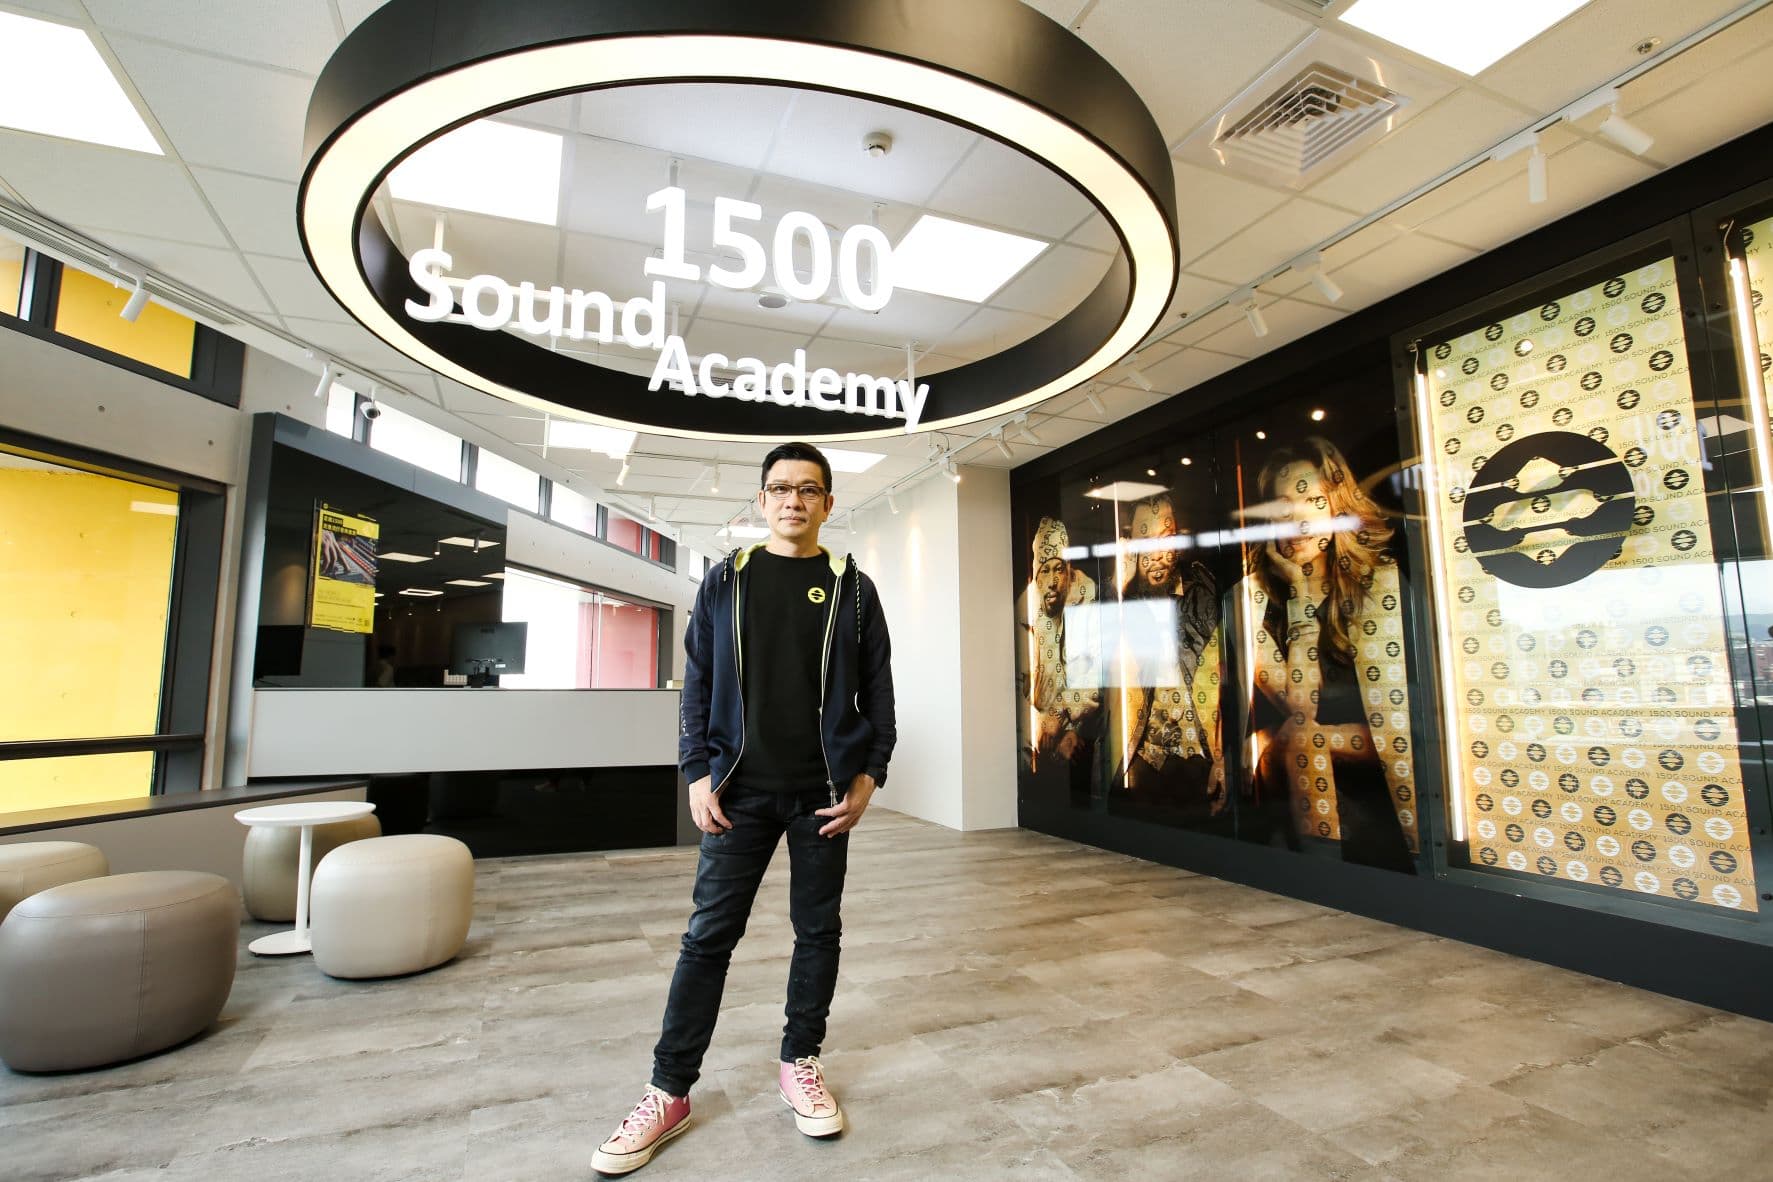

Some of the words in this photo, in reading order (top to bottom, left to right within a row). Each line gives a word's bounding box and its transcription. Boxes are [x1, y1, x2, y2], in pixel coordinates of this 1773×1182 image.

[643, 186, 894, 312] 1500
[404, 248, 667, 350] Sound
[1557, 306, 1596, 325] ACADEMY
[1600, 296, 1622, 310] 1500
[1623, 284, 1655, 302] SOUND
[1560, 333, 1600, 352] ACADEMY
[1626, 313, 1658, 330] SOUND
[1630, 342, 1662, 358] SOUND
[647, 334, 931, 435] Academy
[1633, 371, 1666, 387] SOUND
[1627, 526, 1650, 536] 1500
[1651, 521, 1685, 533] SOUND
[1631, 556, 1653, 566] 1500
[1655, 552, 1689, 563] SOUND
[1600, 708, 1643, 716] ACADEMY
[1648, 709, 1672, 717] 1500
[1673, 709, 1708, 717] SOUND
[1574, 766, 1604, 775] SOUND
[1606, 768, 1650, 778] ACADEMY
[1655, 771, 1679, 780] 1500
[1680, 773, 1716, 783] SOUND
[1609, 798, 1654, 809] ACADEMY
[1659, 803, 1683, 812] 1500
[1684, 805, 1720, 816] SOUND
[1612, 828, 1657, 841] ACADEMY
[1688, 837, 1724, 849] SOUND
[1692, 870, 1729, 883] SOUND
